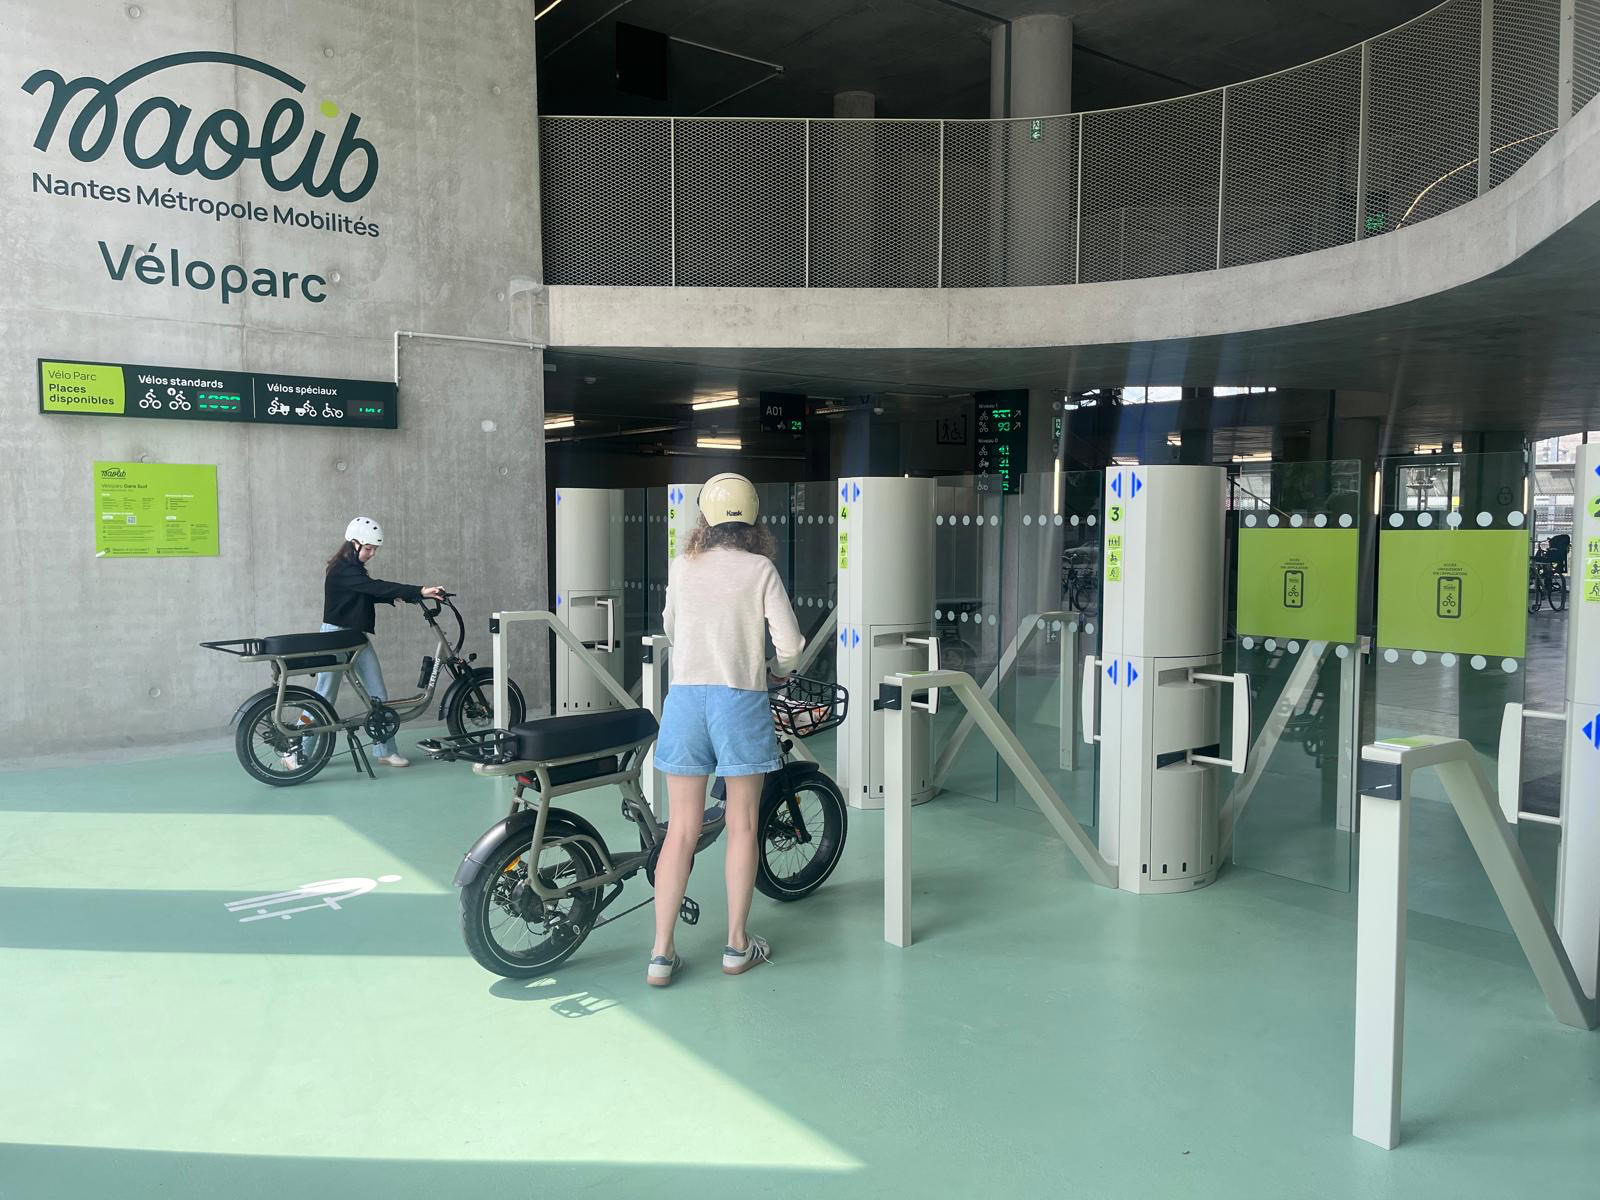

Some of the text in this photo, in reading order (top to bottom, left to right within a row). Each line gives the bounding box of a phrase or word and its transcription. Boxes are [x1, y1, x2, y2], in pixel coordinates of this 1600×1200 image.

[32, 172, 380, 238] Nantes Métropole Mobilités
[97, 240, 328, 304] Véloparc
[48, 370, 97, 381] Vélo Parc
[138, 374, 224, 389] Vélos standards
[48, 383, 87, 394] Places
[267, 383, 338, 396] Vélos spéciaux
[49, 393, 115, 406] disponibles
[841, 507, 847, 519] 4
[1111, 506, 1120, 521] 3
